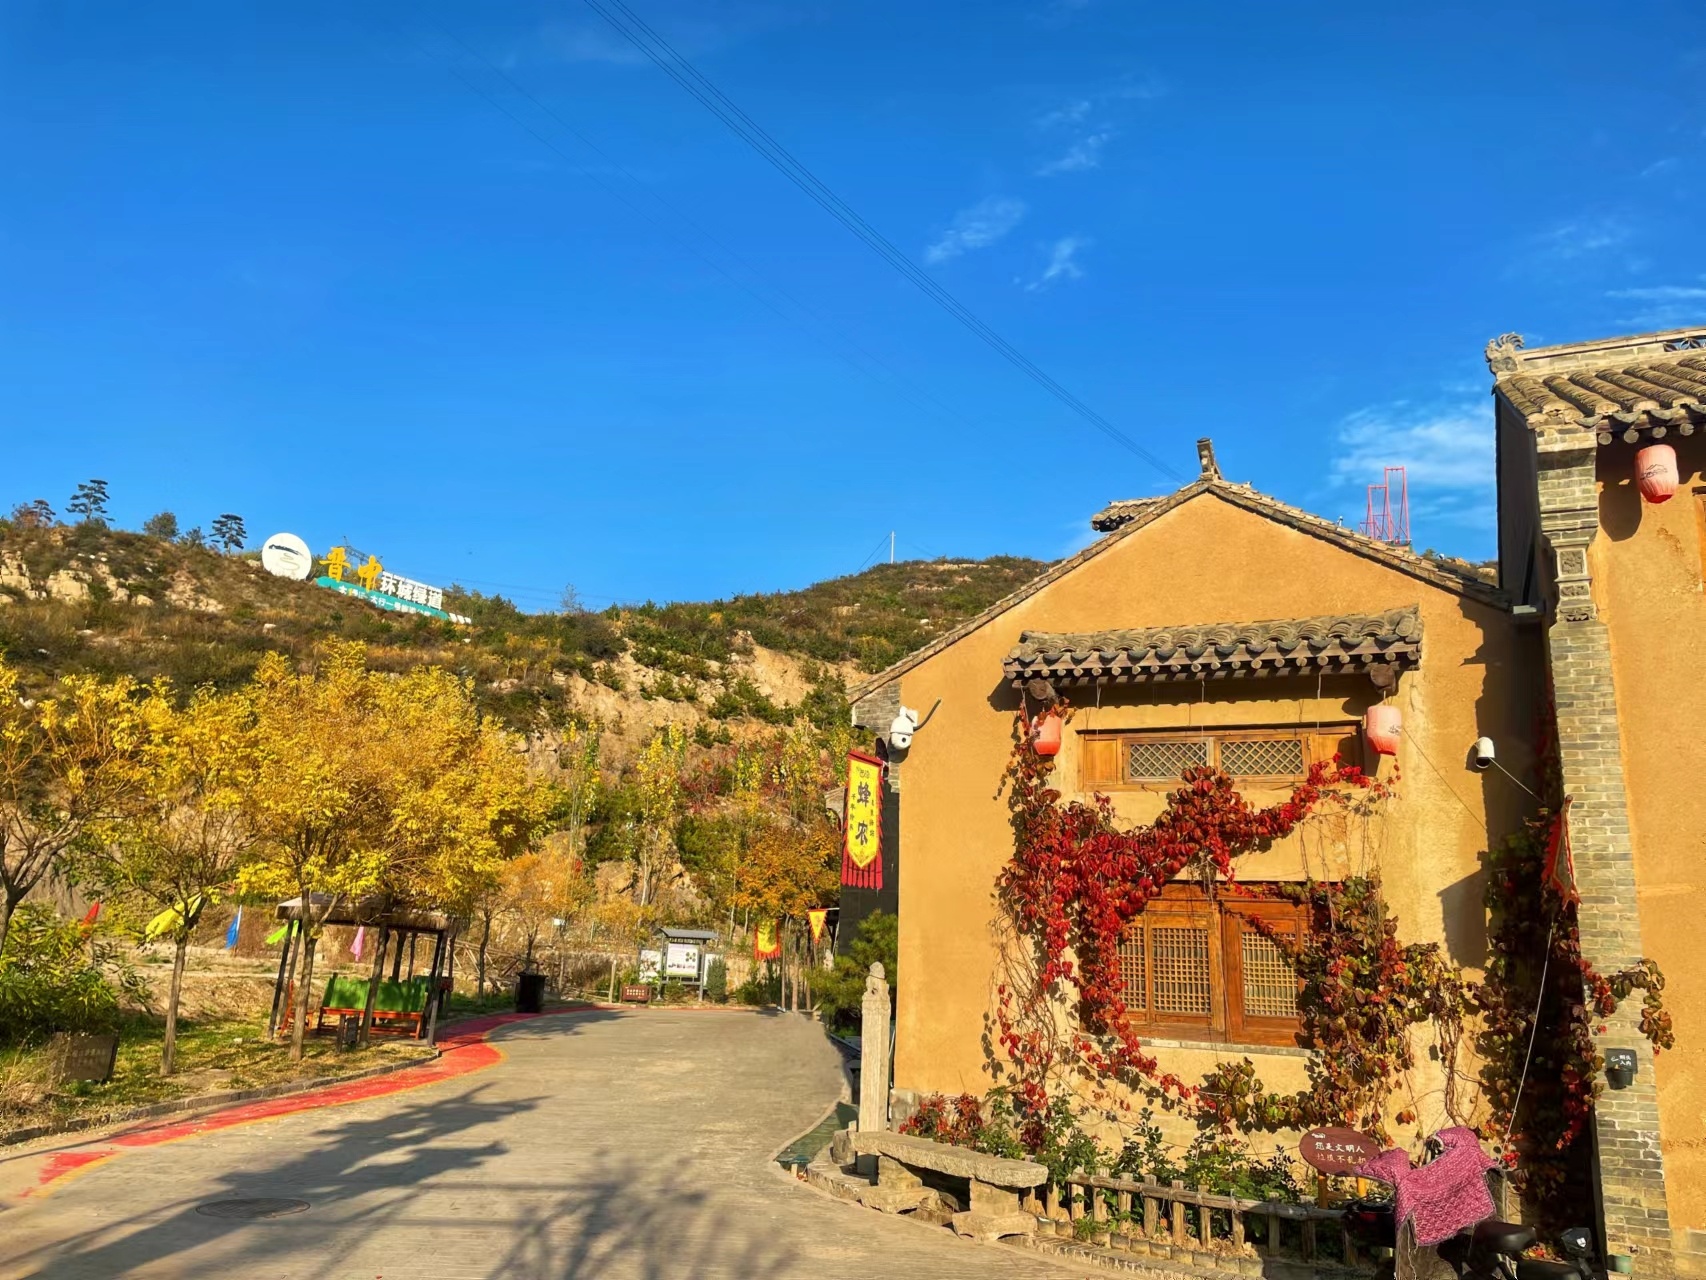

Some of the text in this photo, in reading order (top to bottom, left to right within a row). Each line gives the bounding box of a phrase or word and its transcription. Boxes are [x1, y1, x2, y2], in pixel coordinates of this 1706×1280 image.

[1315, 1141, 1365, 1153] 您是文明人
